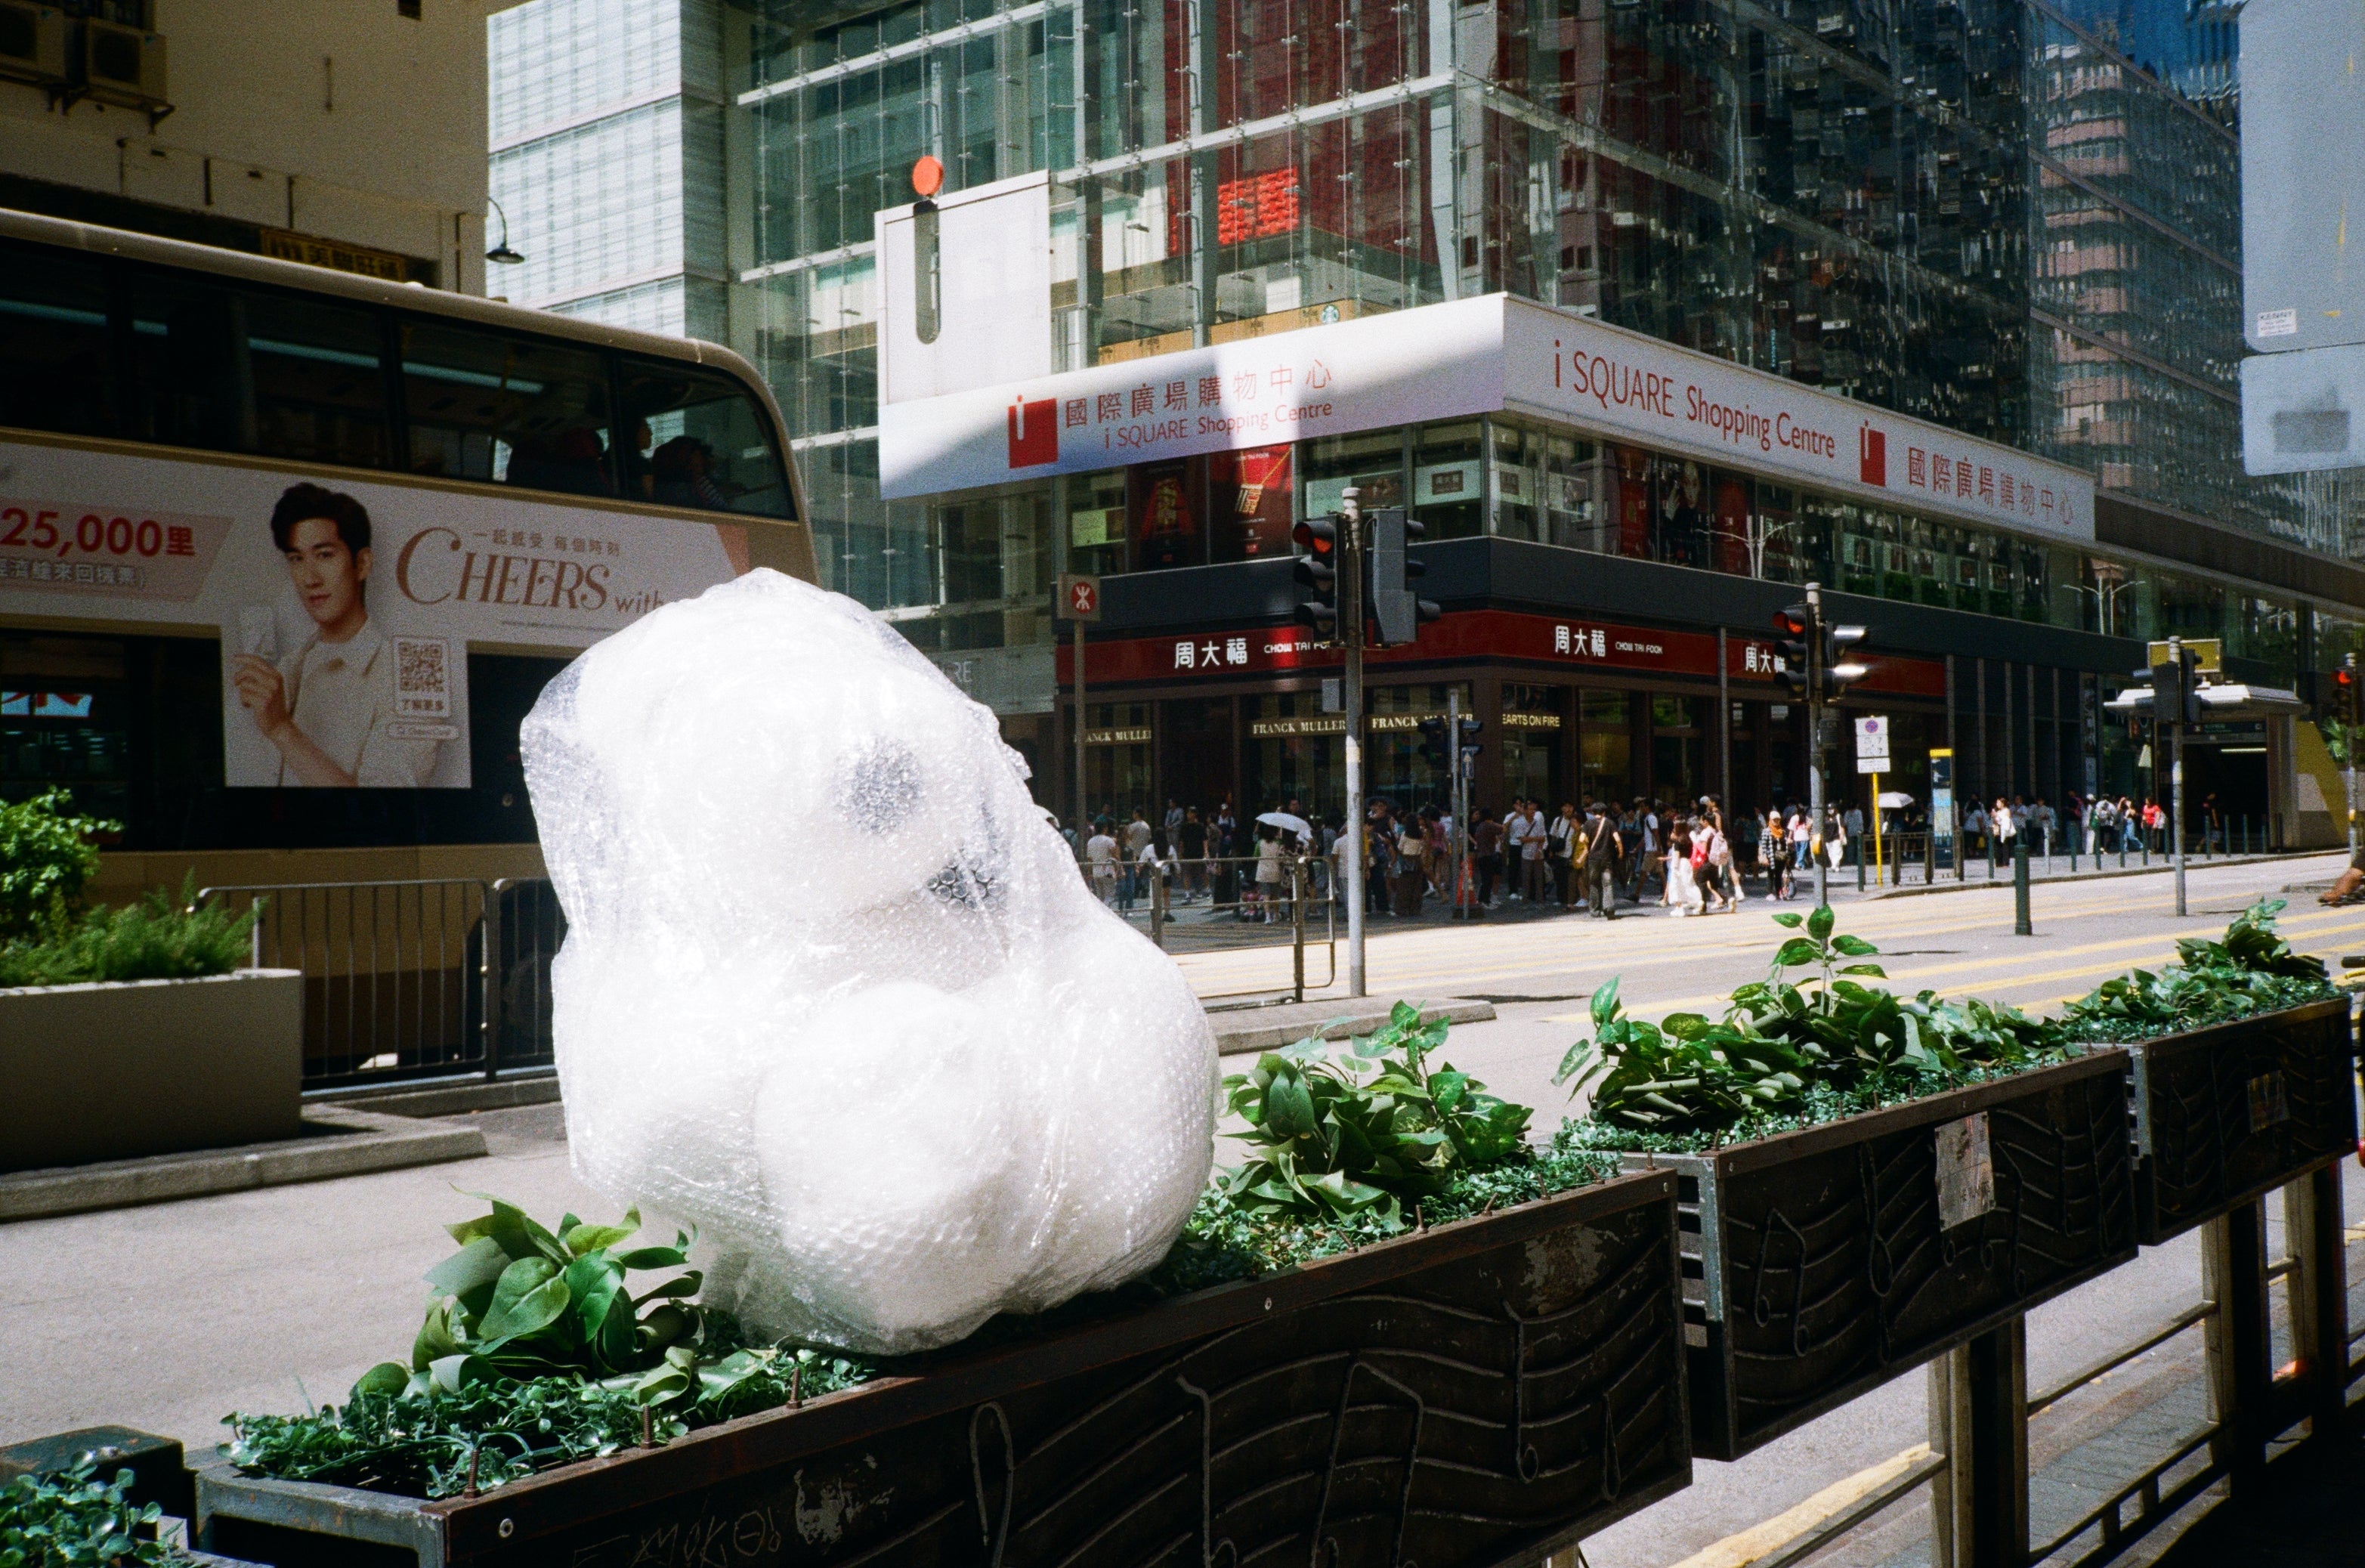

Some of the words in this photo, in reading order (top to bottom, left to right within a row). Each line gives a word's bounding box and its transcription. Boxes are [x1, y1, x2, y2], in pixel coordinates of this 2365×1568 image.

[1065, 358, 1332, 428] 國際廣場購物中心
[1555, 339, 1560, 388] i
[1574, 351, 1674, 417] SQUARE
[1686, 385, 1770, 451] Shopping
[1776, 412, 1835, 458] Centre
[1105, 427, 1110, 449] i
[1117, 418, 1189, 448] SQUARE
[1198, 410, 1269, 436] Shopping
[1275, 402, 1333, 423] Centre
[1908, 446, 2074, 525] 國際廣場購物中心
[395, 527, 610, 611] CHEERS
[1175, 637, 1247, 669] 周大福
[1264, 643, 1292, 654] CHOW
[1294, 642, 1311, 651] TAI
[1554, 625, 1606, 657] 周大福
[1646, 644, 1663, 654] FOOK
[1252, 722, 1296, 735] FRANCK
[1300, 719, 1346, 733] MULLER
[1371, 716, 1418, 729] FRANCK
[1529, 715, 1541, 726] ON
[1542, 716, 1560, 727] FIRE
